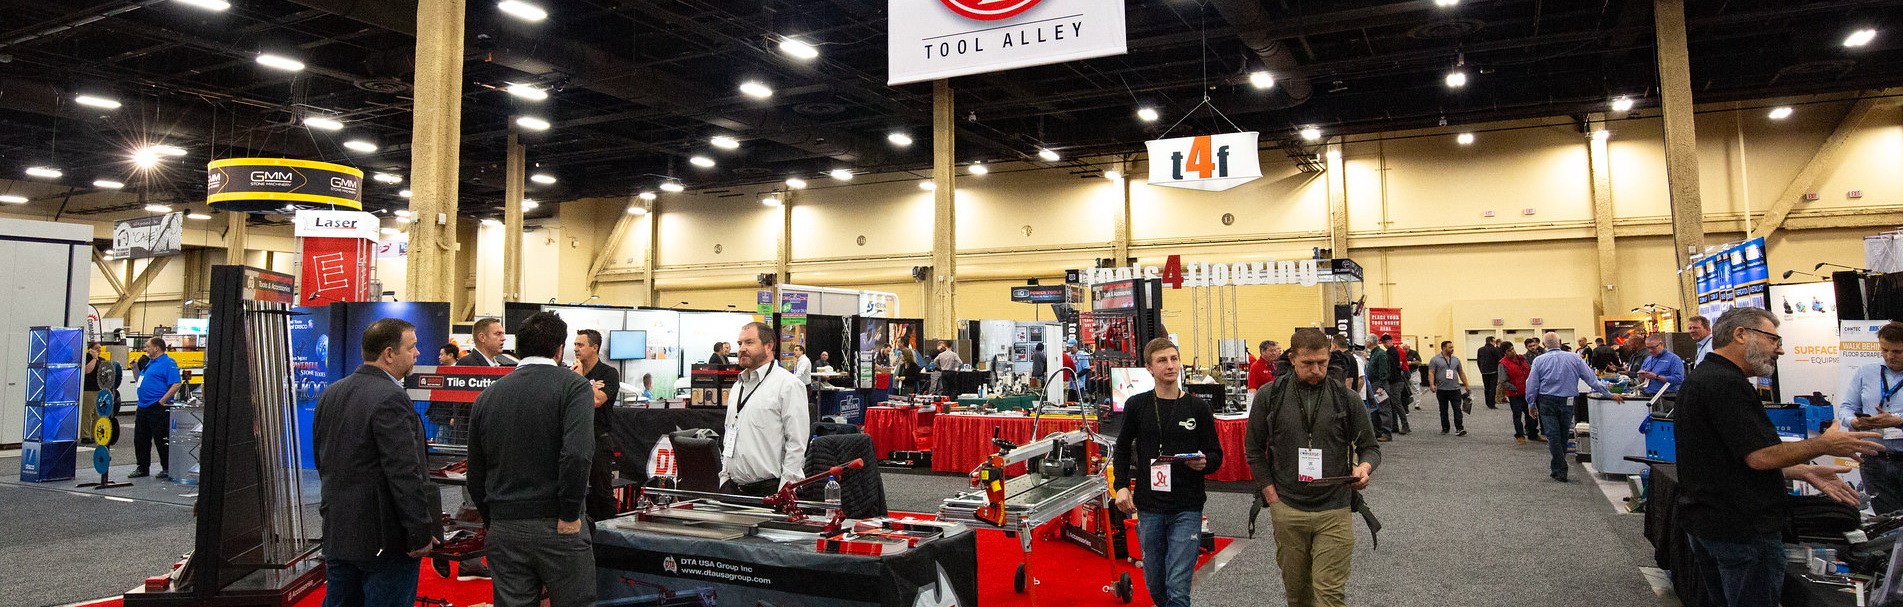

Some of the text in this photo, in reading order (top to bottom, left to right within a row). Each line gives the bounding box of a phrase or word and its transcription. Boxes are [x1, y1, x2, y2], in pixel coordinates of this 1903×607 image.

[925, 21, 1083, 59] TOOL ALLEY
[1171, 135, 1230, 180] t4f
[250, 171, 293, 182] GMM
[330, 176, 357, 189] GMM
[315, 217, 358, 228] Laser
[259, 280, 268, 289] Tools
[1794, 345, 1838, 355] SURFACE
[1842, 342, 1881, 351] WALK BEHIN
[446, 377, 466, 387] Tile
[1070, 532, 1092, 547] Accessories
[680, 558, 753, 573] DTA USA Group Inc
[681, 567, 771, 584] www.dtausagroup.com
